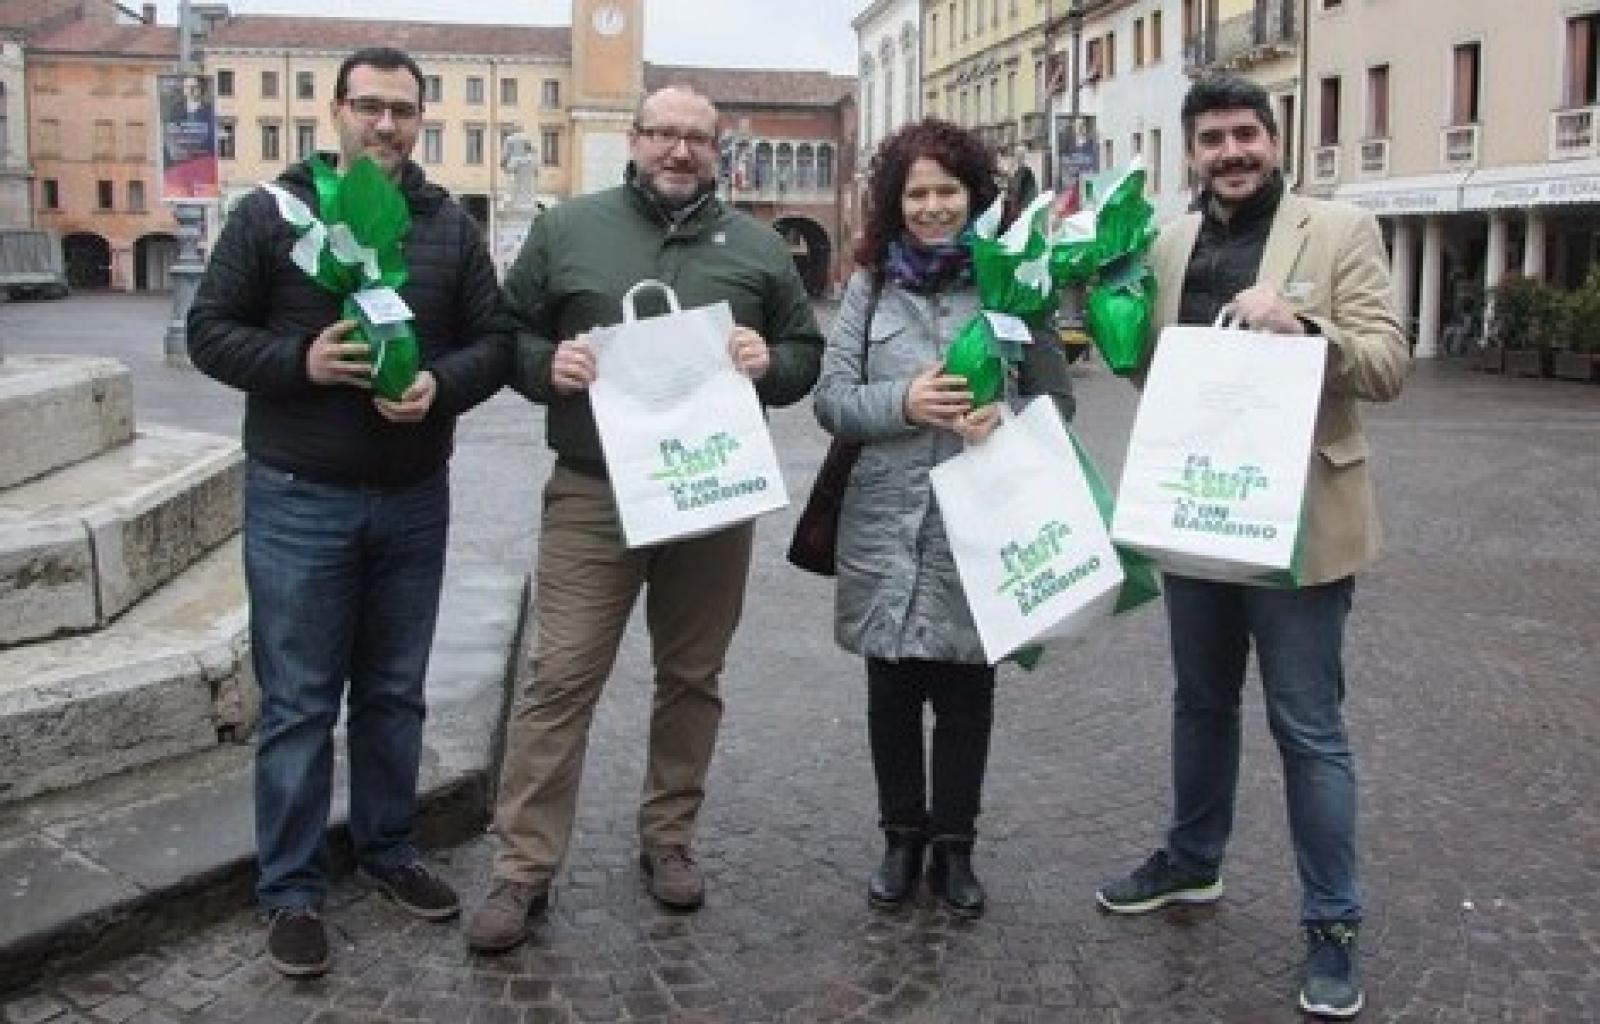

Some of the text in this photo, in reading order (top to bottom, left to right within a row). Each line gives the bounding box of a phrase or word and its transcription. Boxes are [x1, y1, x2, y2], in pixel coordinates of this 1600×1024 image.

[675, 476, 767, 511] BAMBINO
[1173, 512, 1277, 539] BAMBINO
[1018, 556, 1099, 617] BAMBINO
